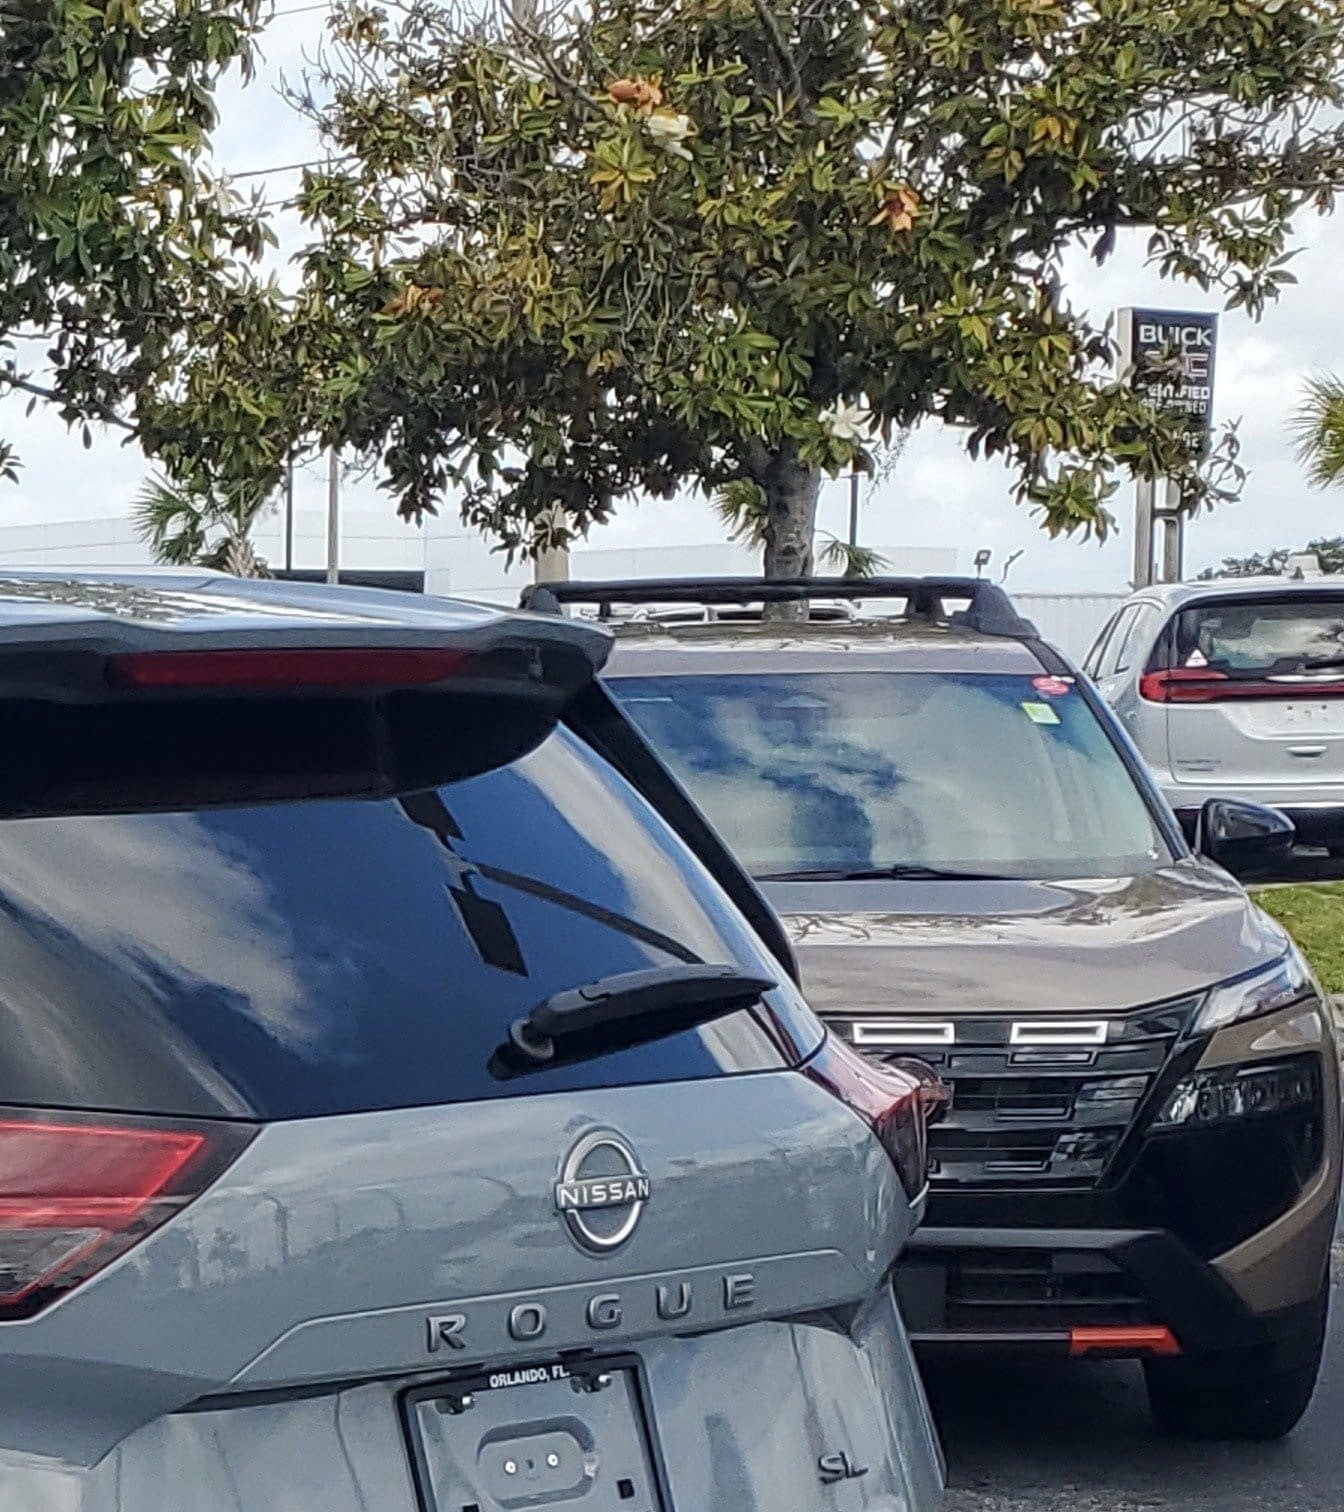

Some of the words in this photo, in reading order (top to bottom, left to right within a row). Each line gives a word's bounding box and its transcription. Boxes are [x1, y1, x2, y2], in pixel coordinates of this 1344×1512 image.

[1139, 324, 1213, 346] BUICK
[560, 1178, 650, 1207] NISSAN
[425, 1273, 755, 1353] ROGUE
[489, 1370, 549, 1388] ORLANDO,
[552, 1365, 571, 1379] FL.
[818, 1450, 869, 1485] SL
